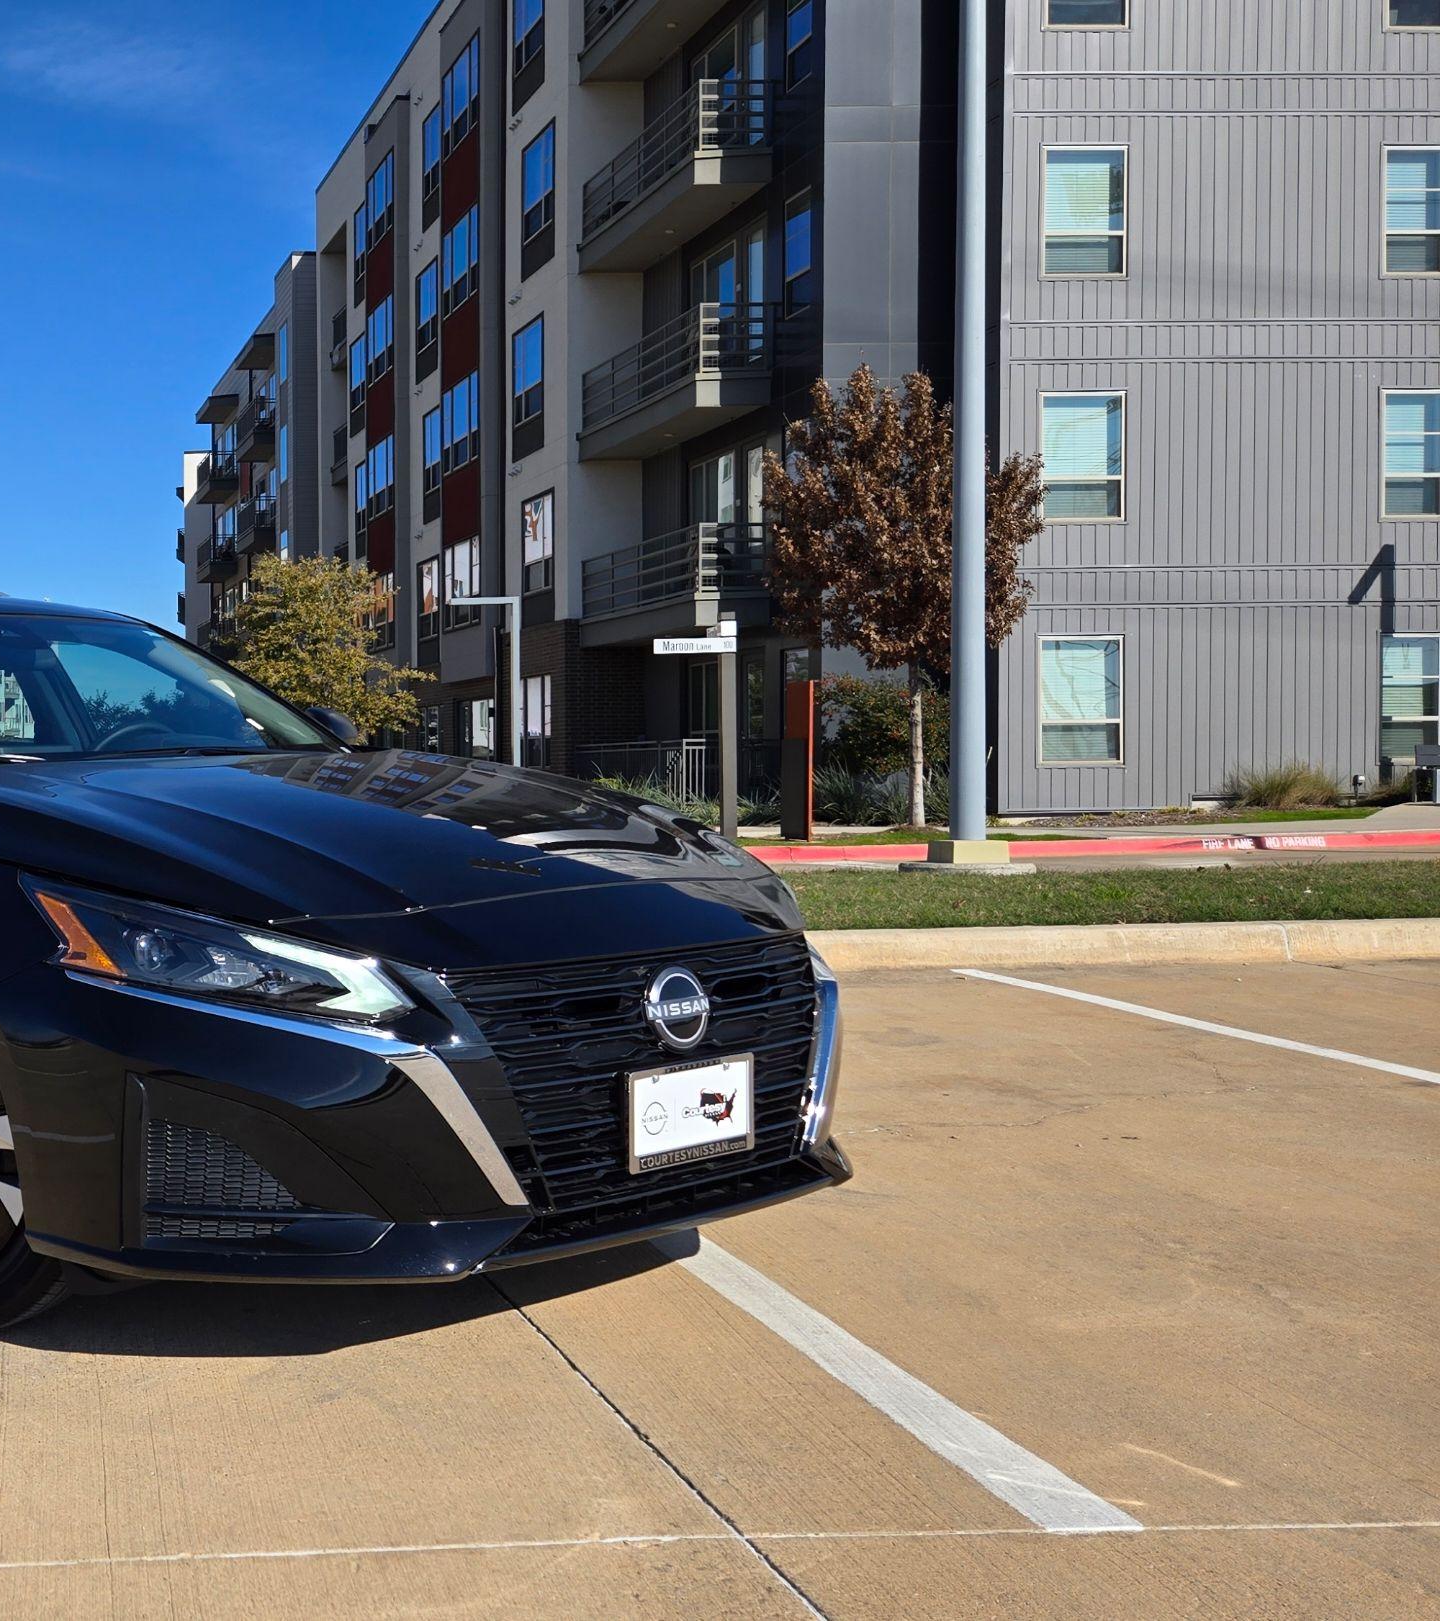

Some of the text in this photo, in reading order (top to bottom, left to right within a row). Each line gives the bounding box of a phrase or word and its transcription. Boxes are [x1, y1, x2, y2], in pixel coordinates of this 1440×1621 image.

[662, 641, 694, 651] Maroon
[1202, 837, 1327, 849] FIRE LANE NO PARKING
[648, 998, 709, 1018] NISSAN
[682, 1103, 727, 1118] Courtesy
[641, 1113, 668, 1123] NISSAN
[640, 1140, 746, 1169] COURTESYNISSAN.com
